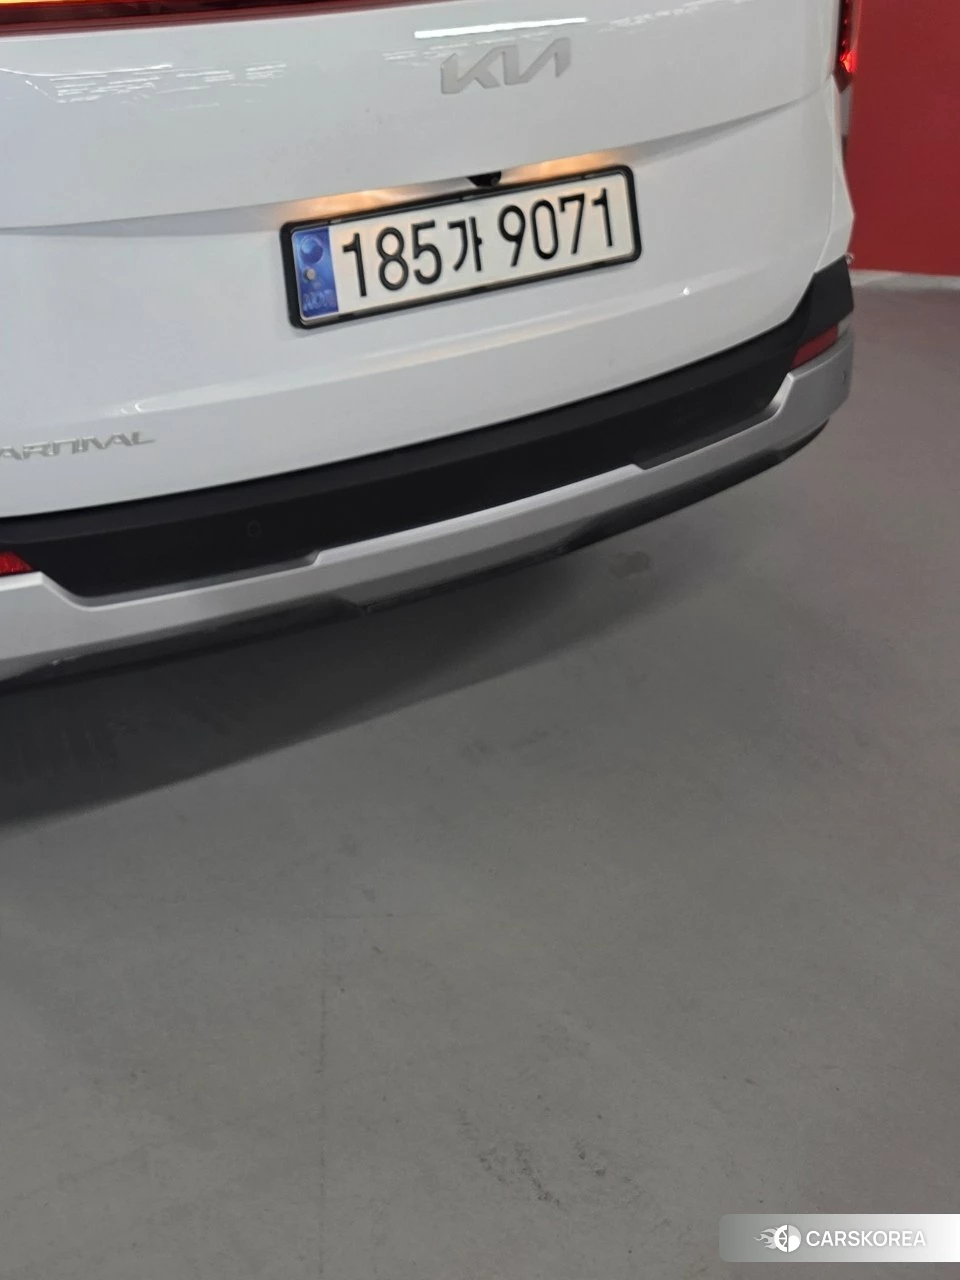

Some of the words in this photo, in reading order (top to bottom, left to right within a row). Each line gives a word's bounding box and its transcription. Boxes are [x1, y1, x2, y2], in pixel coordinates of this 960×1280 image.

[441, 37, 571, 95] KIA
[342, 216, 483, 298] 185가
[498, 187, 614, 268] 9071
